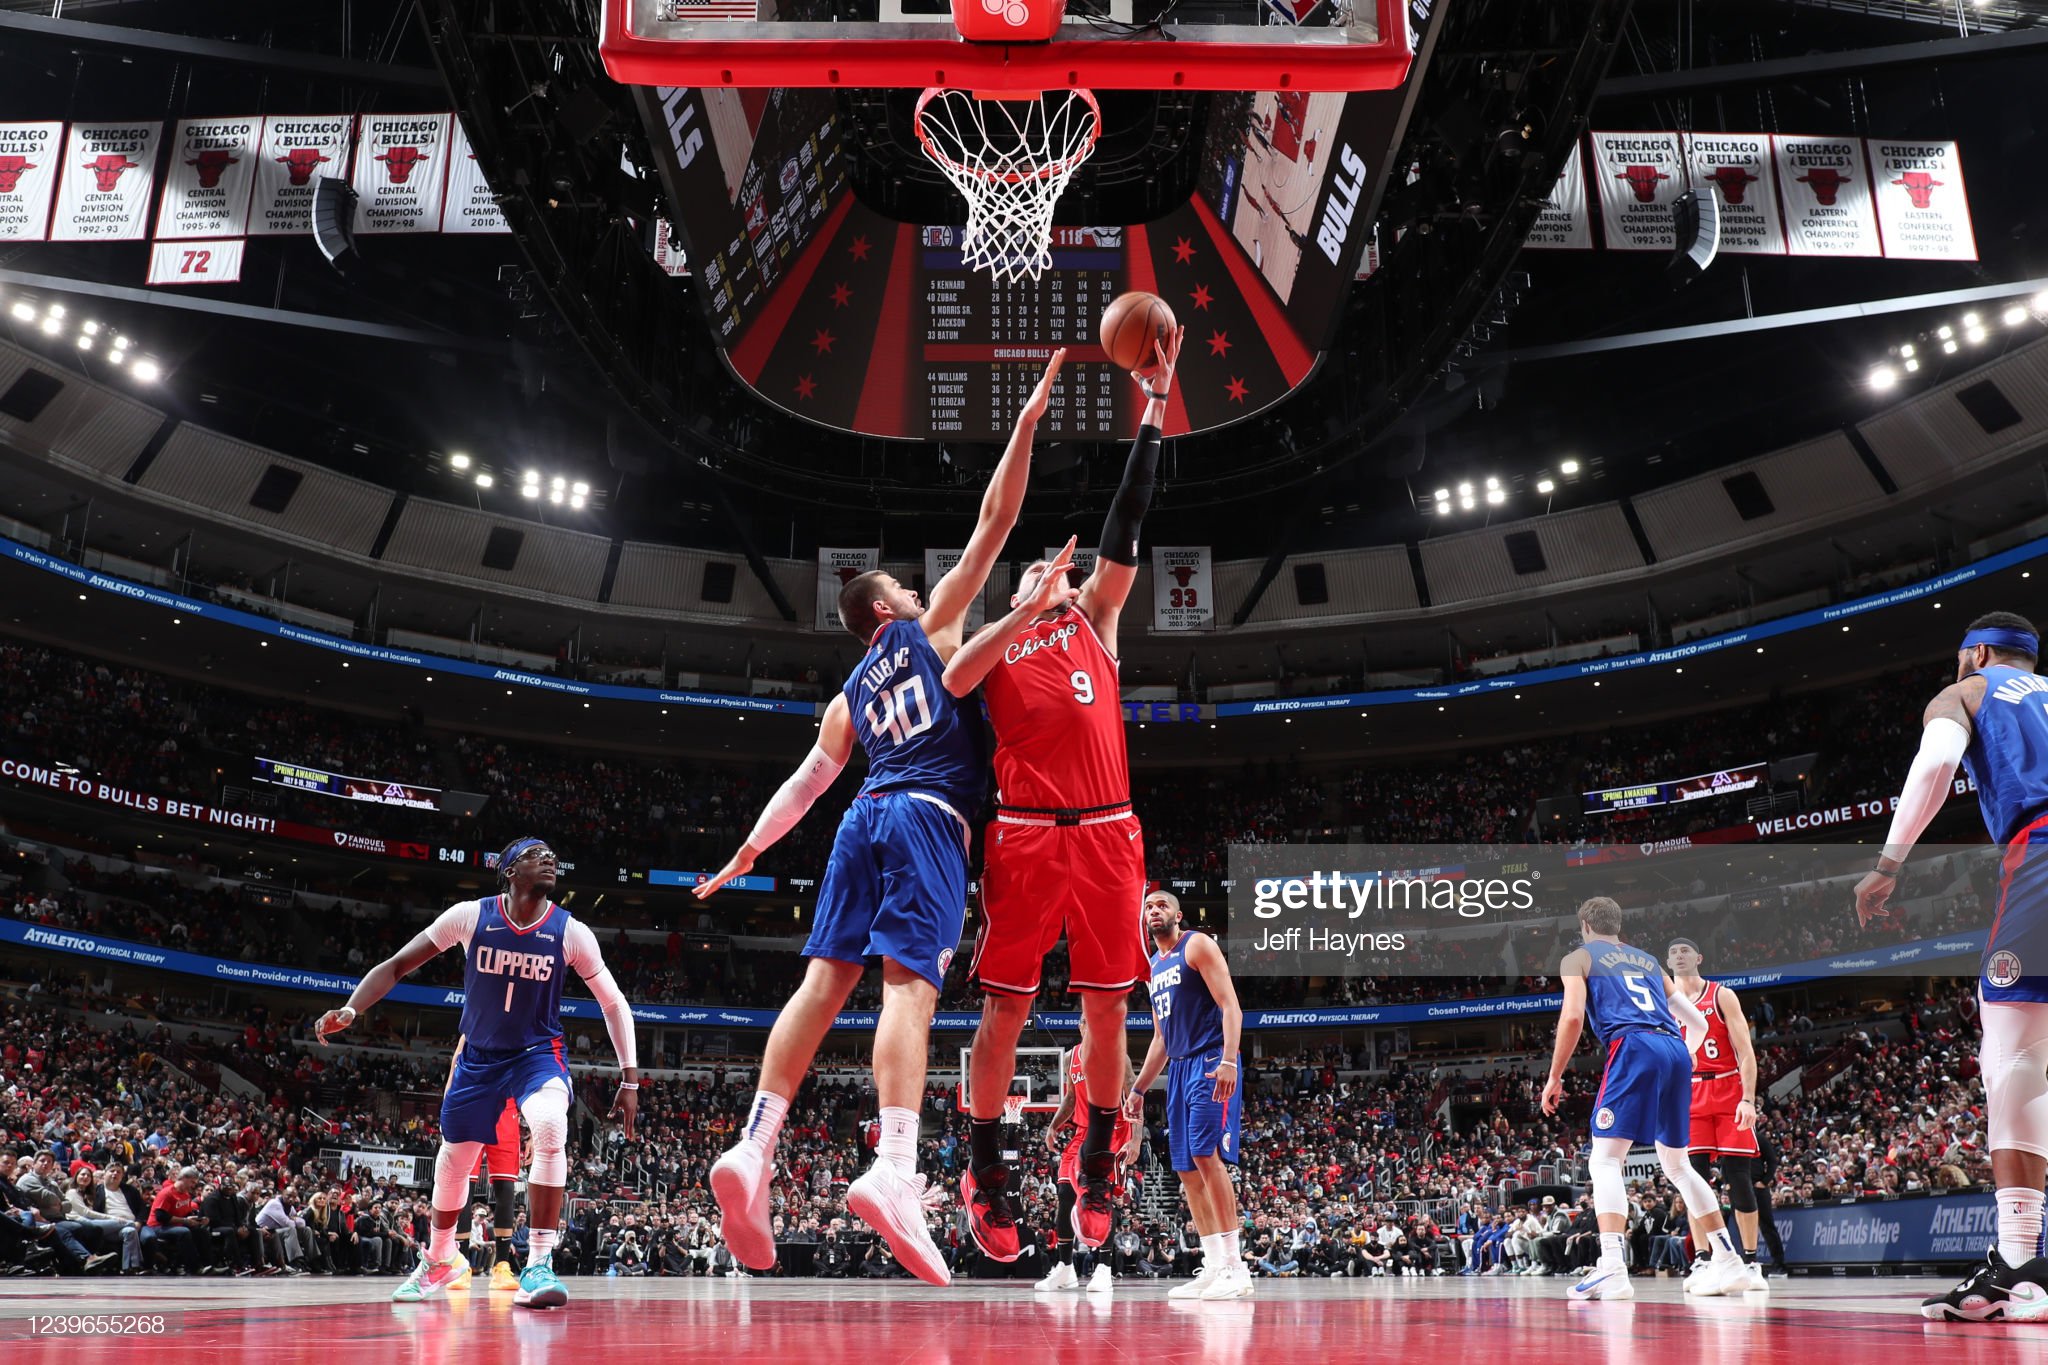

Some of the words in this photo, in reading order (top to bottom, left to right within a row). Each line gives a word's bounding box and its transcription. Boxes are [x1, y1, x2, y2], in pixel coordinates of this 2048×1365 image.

[186, 124, 250, 136] CHICAGO
[275, 123, 342, 134] CHICAGO
[372, 121, 438, 132] CHICAGO
[82, 130, 149, 140] CHICAGO
[381, 134, 428, 145] BULLS
[194, 138, 239, 149] BULLS
[284, 136, 330, 146] BULLS
[1606, 140, 1670, 151] CHICAGO
[90, 142, 138, 152] BULLS
[1694, 142, 1758, 152] CHICAGO
[1786, 144, 1851, 154] CHICAGO
[1881, 146, 1944, 158] CHICAGO
[1618, 153, 1664, 163] BULLS
[1799, 156, 1844, 166] BULLS
[1893, 160, 1938, 170] BULLS
[188, 188, 226, 198] CENTRAL
[378, 186, 416, 195] CENTRAL
[84, 194, 124, 202] CENTRAL
[375, 197, 417, 206] DIVISION
[80, 204, 124, 212] DIVISION
[184, 200, 226, 208] DIVISION
[1316, 142, 1367, 266] BULLS
[1628, 204, 1667, 212] EASTERN
[176, 210, 230, 220] CHAMPIONS
[366, 208, 424, 217] CHAMPIONS
[1809, 208, 1848, 216] EASTERN
[72, 214, 129, 224] CHAMPIONS
[1802, 218, 1859, 228] CONFERENCE
[1898, 222, 1953, 231] CONFERENCE
[1060, 230, 1082, 244] 118
[1805, 230, 1860, 238] CHAMPIONS
[1900, 232, 1954, 242] CHAMPIONS
[180, 250, 211, 274] 72
[937, 306, 960, 315] MORRIS
[938, 319, 966, 327] JACKSON
[938, 332, 959, 340] BATUM
[994, 349, 1026, 358] CHICAGO
[1028, 349, 1050, 358] BULLS
[938, 372, 968, 382] WILLIAMS
[938, 385, 964, 394] VUCEVIC
[938, 398, 966, 406] DEROZAN
[938, 410, 960, 419] LAVINE
[938, 422, 962, 431] CARUSO
[831, 552, 867, 560] CHICAGO
[1170, 558, 1196, 566] BULLS
[16, 548, 24, 557] In
[25, 550, 46, 566] Pain?
[49, 561, 68, 576] Start
[69, 567, 86, 580] with
[89, 576, 145, 598] ATHLETICO
[145, 593, 174, 606] PHYSICAL
[175, 600, 202, 612] THERAPY
[1170, 588, 1198, 608] 33
[1824, 610, 1840, 619] Free
[1841, 597, 1889, 616] assessments
[1890, 586, 1924, 604] available
[1925, 584, 1933, 593] at
[1933, 580, 1942, 591] all
[1943, 568, 1976, 587] locations
[279, 626, 295, 636] Free
[296, 631, 340, 650] assessments
[340, 642, 370, 656] available
[372, 650, 379, 658] at
[380, 650, 388, 659] all
[390, 652, 421, 664] locations
[1004, 622, 1078, 665] Chicago
[1590, 663, 1608, 672] Pain?
[1612, 660, 1629, 668] Start
[1630, 657, 1645, 665] with
[1649, 646, 1697, 663] ATHLETICO
[1698, 640, 1723, 652] PHYSICAL
[1723, 634, 1748, 647] THERAPY
[861, 647, 910, 694] ZUBAC
[494, 670, 542, 686] ATHLETICO
[542, 680, 566, 690] PHYSICAL
[566, 684, 590, 694] THERAPY
[1070, 670, 1095, 705] 9
[660, 693, 684, 702] Chosen
[685, 695, 712, 704] Provider
[720, 698, 746, 710] Physical
[748, 700, 774, 710] Therapy
[1253, 700, 1300, 712] ATHLETICO
[865, 674, 932, 746] 40
[274, 764, 294, 776] SPRING
[295, 768, 329, 784] AWAKENING
[1602, 790, 1622, 802] SPRING
[1624, 786, 1658, 800] AWAKENING
[67, 776, 92, 794] TO
[98, 784, 159, 812] BULLS
[166, 800, 203, 820] BET
[209, 808, 276, 833] NIGHT!
[1756, 807, 1853, 836] WELCOME
[1857, 799, 1883, 818] TO
[348, 836, 386, 848] FANDUEL
[1654, 836, 1692, 848] FANDUEL
[438, 846, 466, 864] 9:40
[1502, 863, 1528, 875] STEALS
[790, 878, 814, 886] TIMEOUTS
[24, 928, 95, 952] ATHLETICO
[96, 944, 131, 959] PHYSICAL
[132, 951, 165, 964] THERAPY
[476, 945, 555, 982] CLIPPERS
[1599, 953, 1655, 972] KENNARD
[216, 964, 250, 978] Chosen
[251, 968, 289, 984] Provider
[291, 974, 300, 983] of
[302, 974, 339, 992] Physical
[1748, 972, 1783, 984] THERAPY
[1622, 970, 1656, 1012] 5
[504, 982, 514, 1013] 1
[1154, 991, 1171, 1021] 33
[1428, 1006, 1458, 1017] Chosen
[1460, 1003, 1493, 1014] Provider
[1495, 1002, 1504, 1012] of
[1504, 1000, 1540, 1014] Physical
[937, 1018, 968, 1026] PHYSICAL
[1045, 1017, 1063, 1025] Free
[1259, 1014, 1317, 1025] ATHLETICO
[1318, 1013, 1349, 1022] PHYSICAL
[1350, 1012, 1380, 1022] THERAPY
[1704, 1038, 1720, 1059] 6
[1812, 1222, 1836, 1246] Pain
[1839, 1220, 1868, 1245] Ends
[1870, 1218, 1900, 1244] Here
[1930, 1236, 1964, 1252] PHYSICAL
